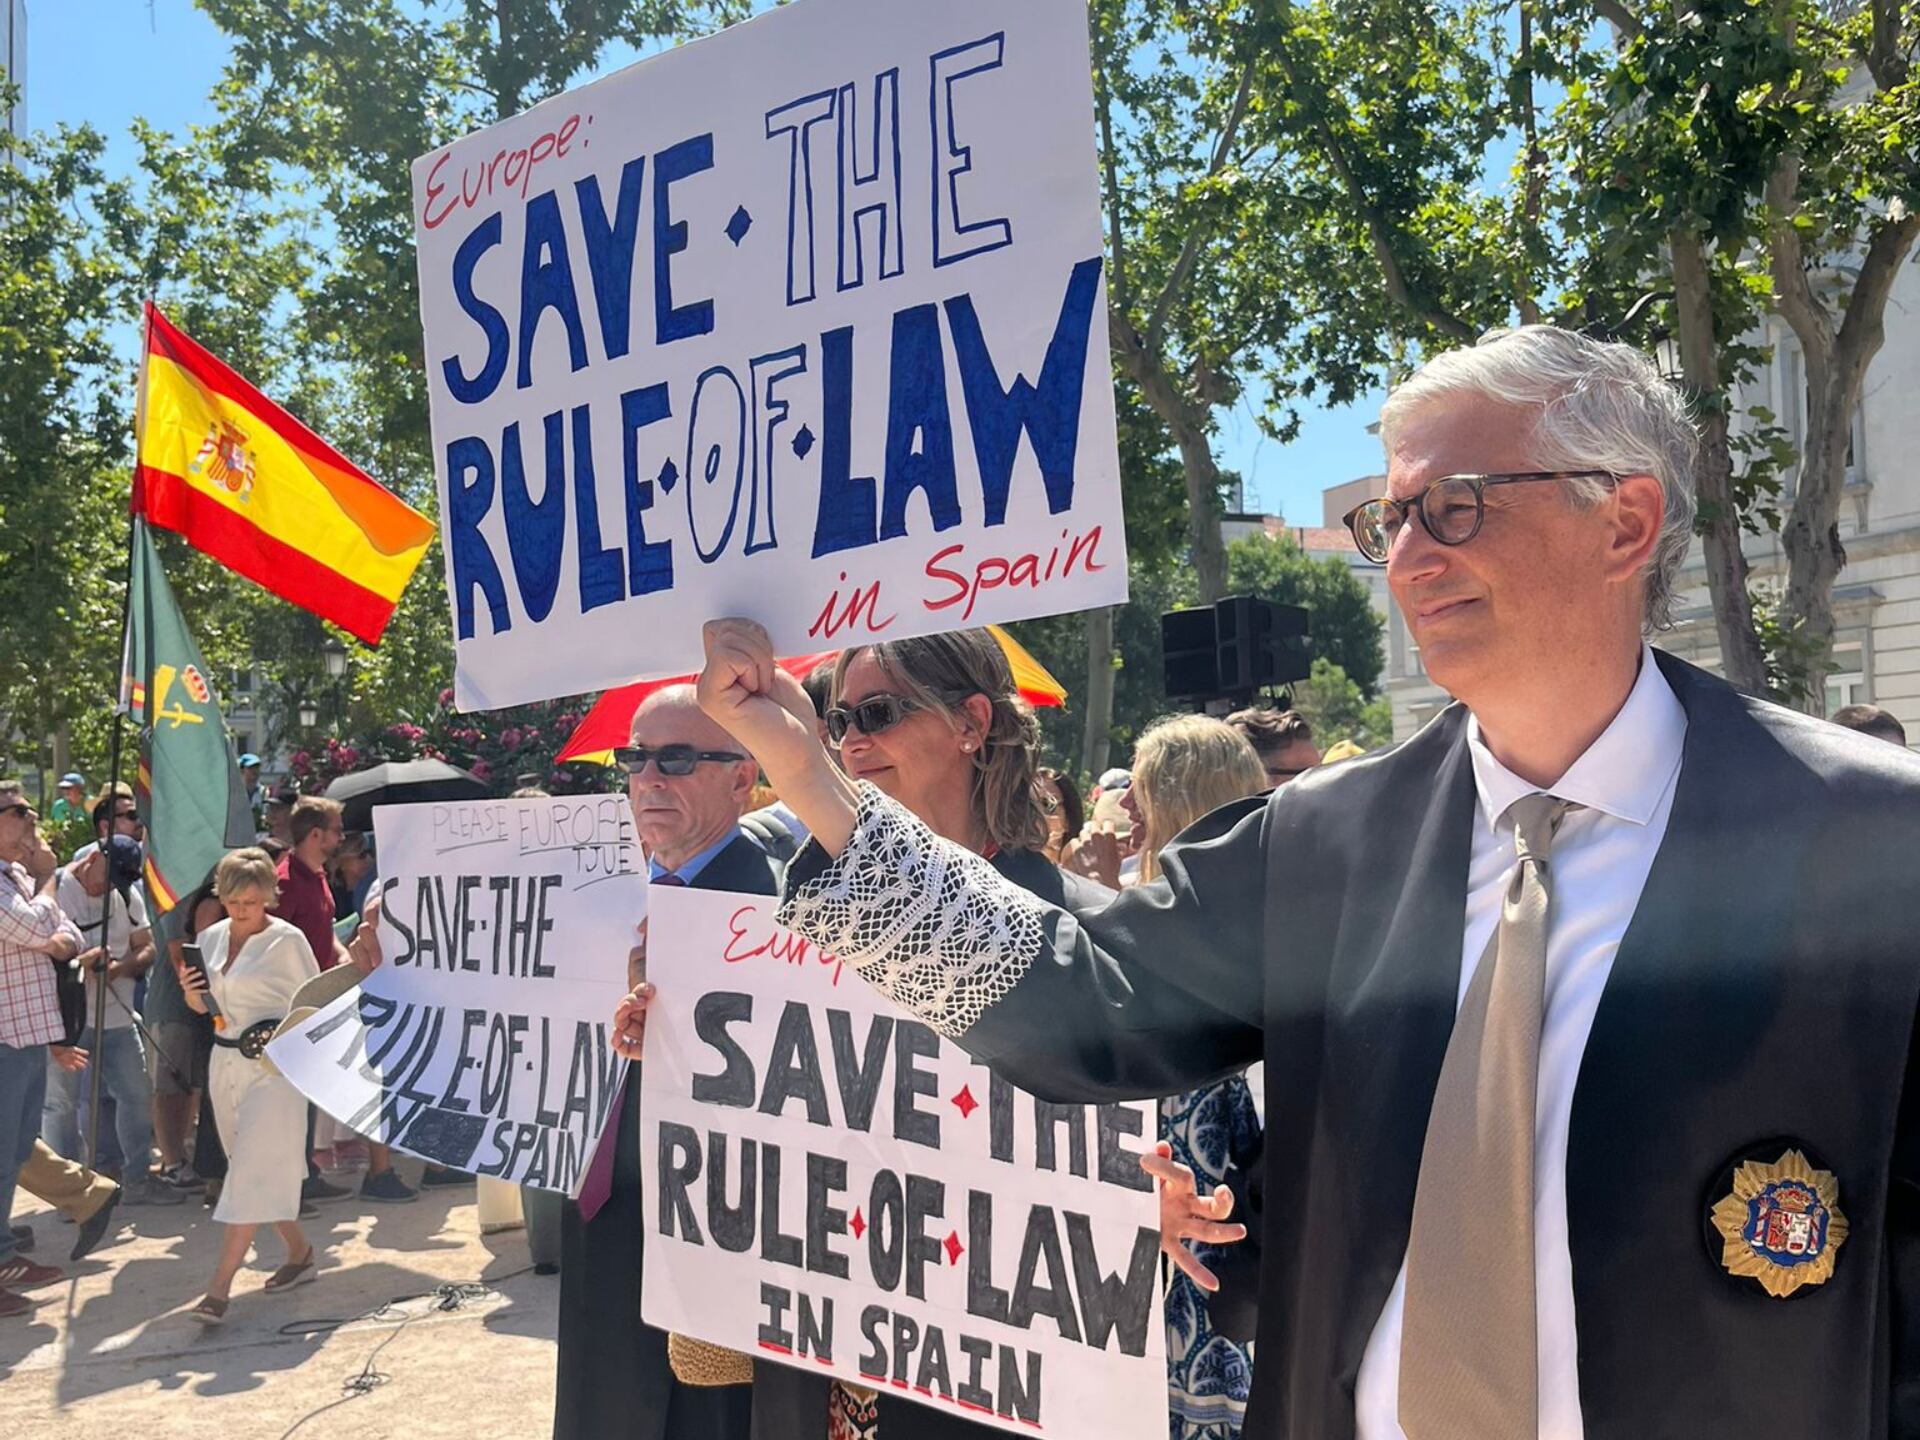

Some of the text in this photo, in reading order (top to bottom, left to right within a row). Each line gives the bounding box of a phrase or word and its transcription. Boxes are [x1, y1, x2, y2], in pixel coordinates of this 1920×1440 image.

[423, 112, 593, 229] Europe:
[443, 31, 1012, 403] SAVE THE
[446, 257, 1102, 640] RULE OF LAW
[808, 525, 1107, 638] in Spain
[432, 799, 632, 850] PLEASE EUROPE
[572, 845, 631, 874] TJUE
[381, 874, 562, 978] SAVE THE
[305, 992, 486, 1111] RULE
[479, 1012, 529, 1119] OF
[692, 990, 941, 1149] SAVE
[477, 1119, 588, 1192] SPAIN
[657, 1121, 1161, 1358] RULE OF LAW
[759, 1281, 1043, 1422] IN SPAIN
